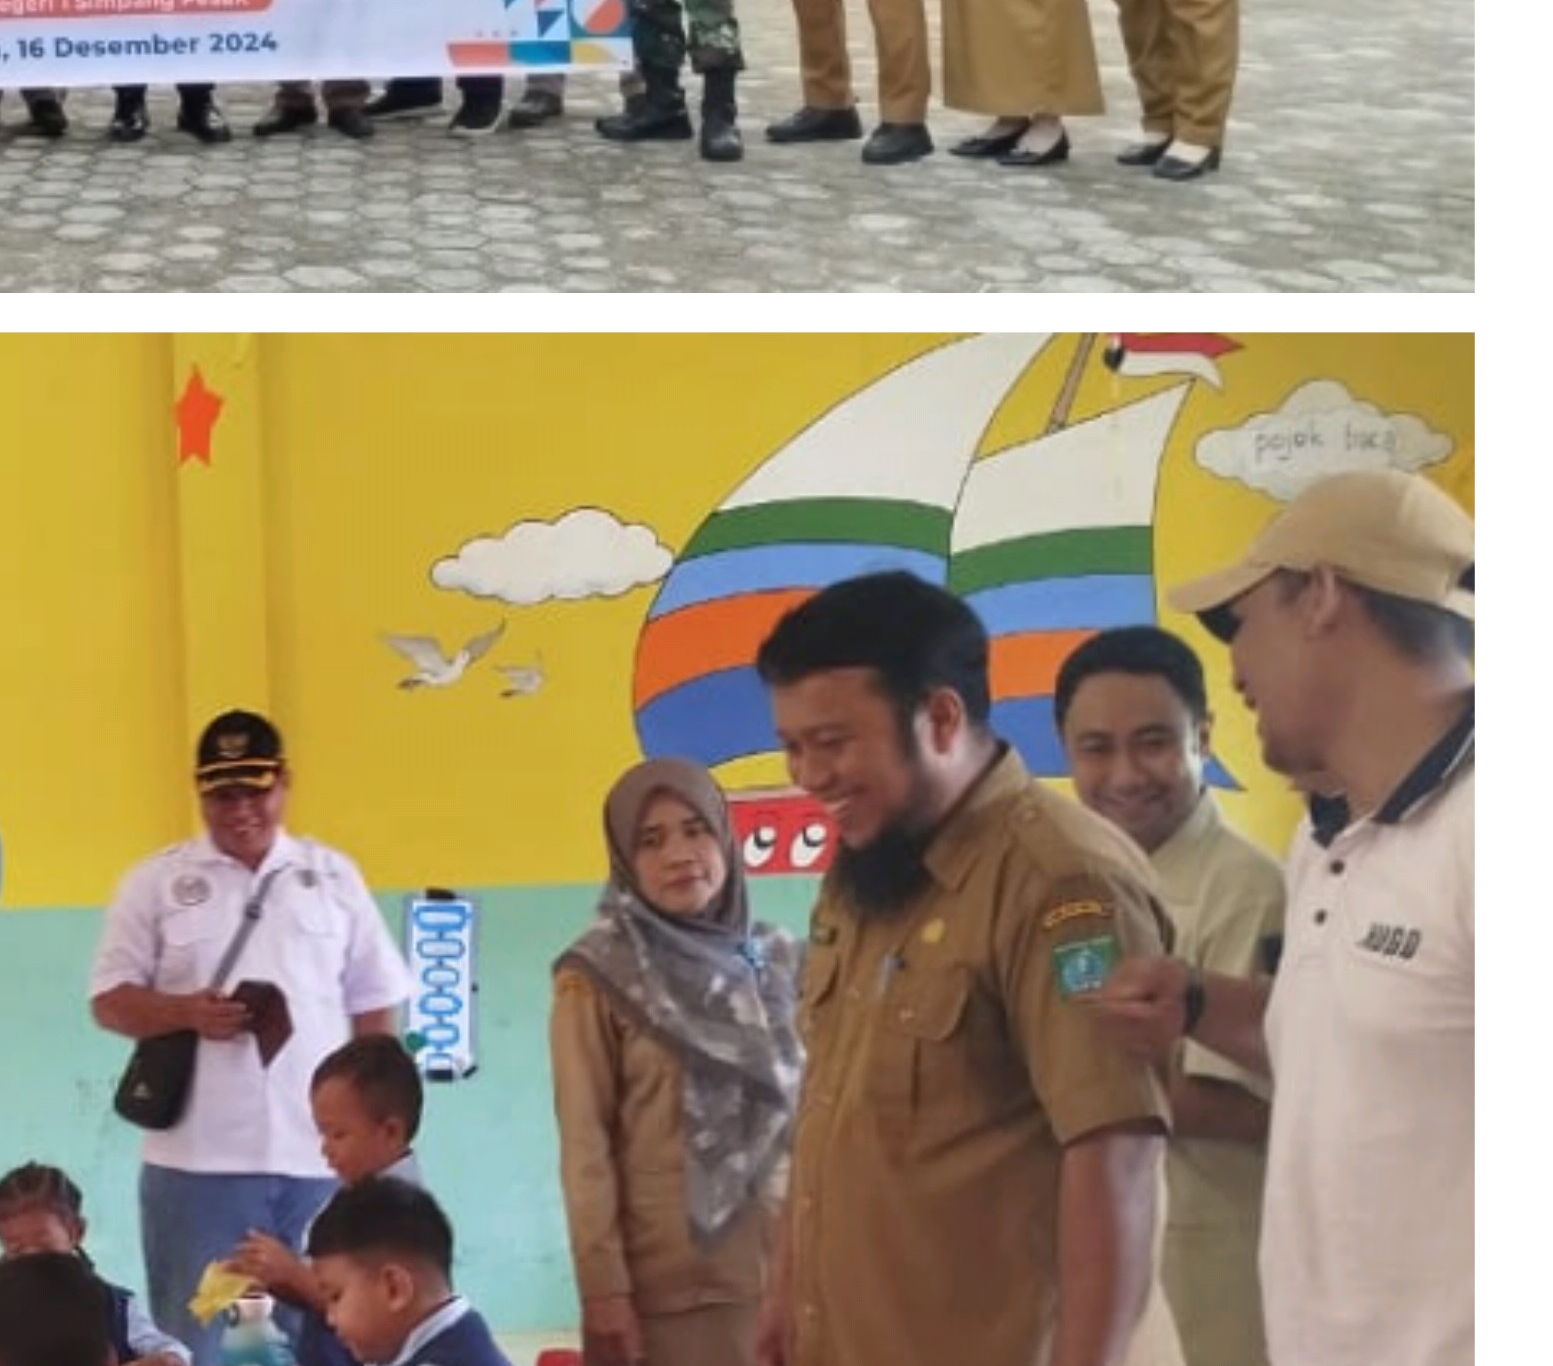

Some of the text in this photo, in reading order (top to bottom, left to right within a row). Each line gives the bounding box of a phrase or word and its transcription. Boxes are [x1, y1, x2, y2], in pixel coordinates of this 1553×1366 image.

[16, 37, 45, 59] 16
[54, 33, 200, 58] Desember
[209, 32, 279, 54] 2024
[1253, 419, 1325, 465] pojok
